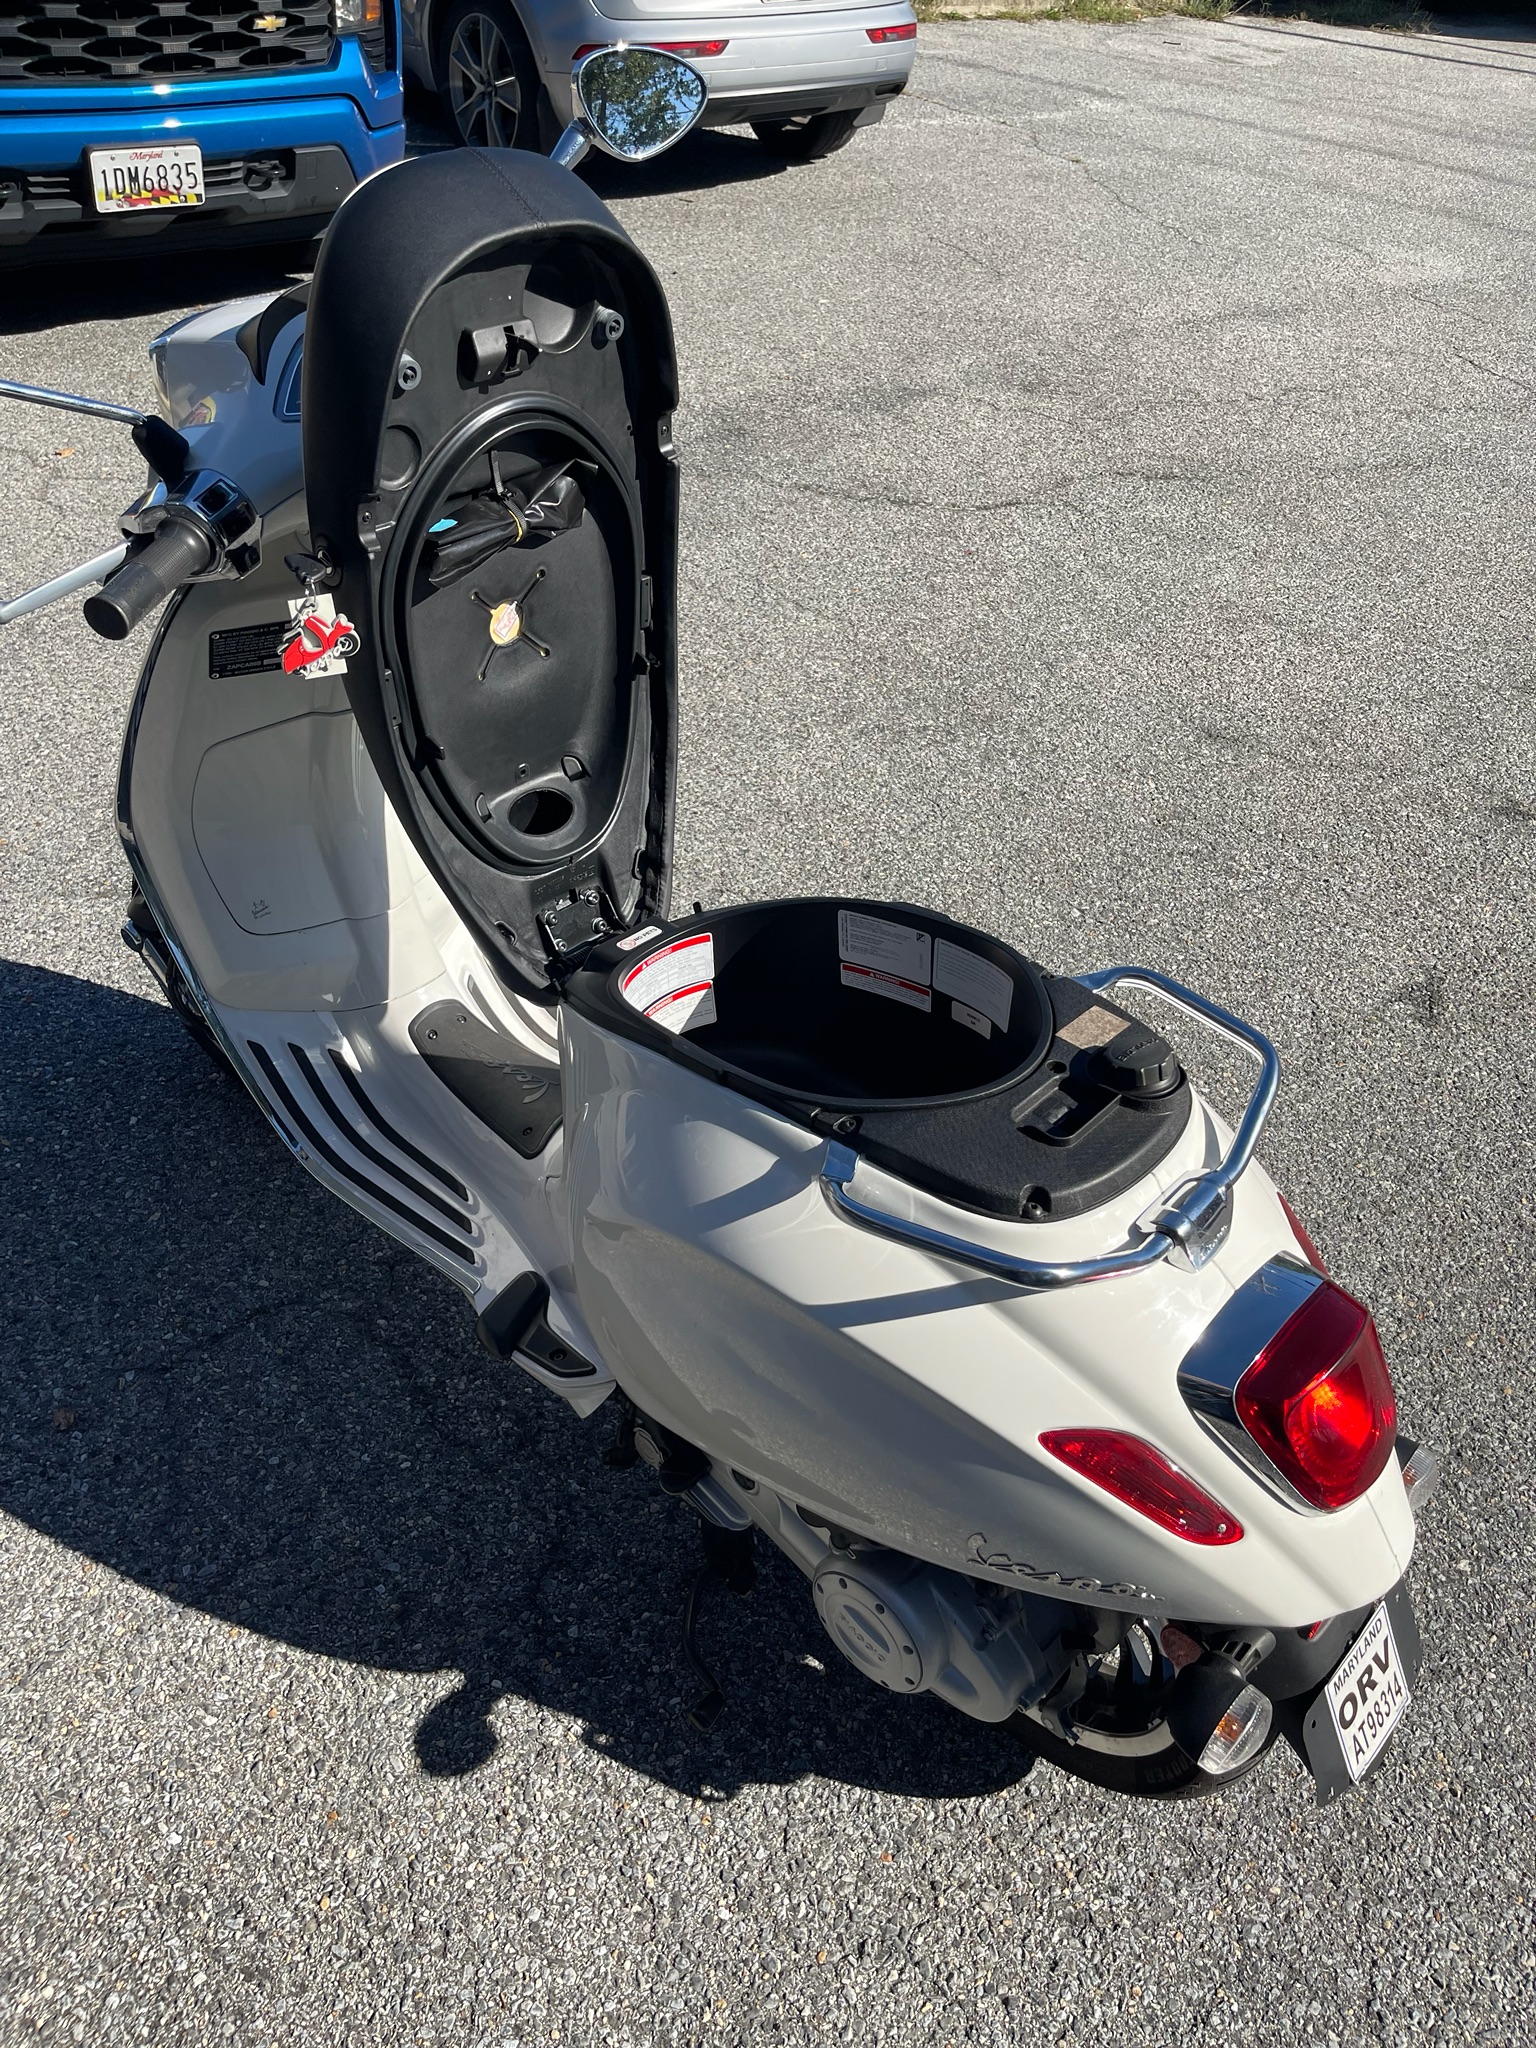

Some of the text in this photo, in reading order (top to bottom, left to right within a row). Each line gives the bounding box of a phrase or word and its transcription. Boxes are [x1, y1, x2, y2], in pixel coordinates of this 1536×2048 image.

[101, 162, 198, 198] 1DM6835
[129, 150, 164, 162] Maryland
[643, 927, 658, 940] PETS
[838, 1611, 888, 1664] PIAGGIO
[1333, 1617, 1383, 1696] MARYLAND
[1338, 1634, 1390, 1731] ORV
[1352, 1671, 1403, 1765] AT98314
